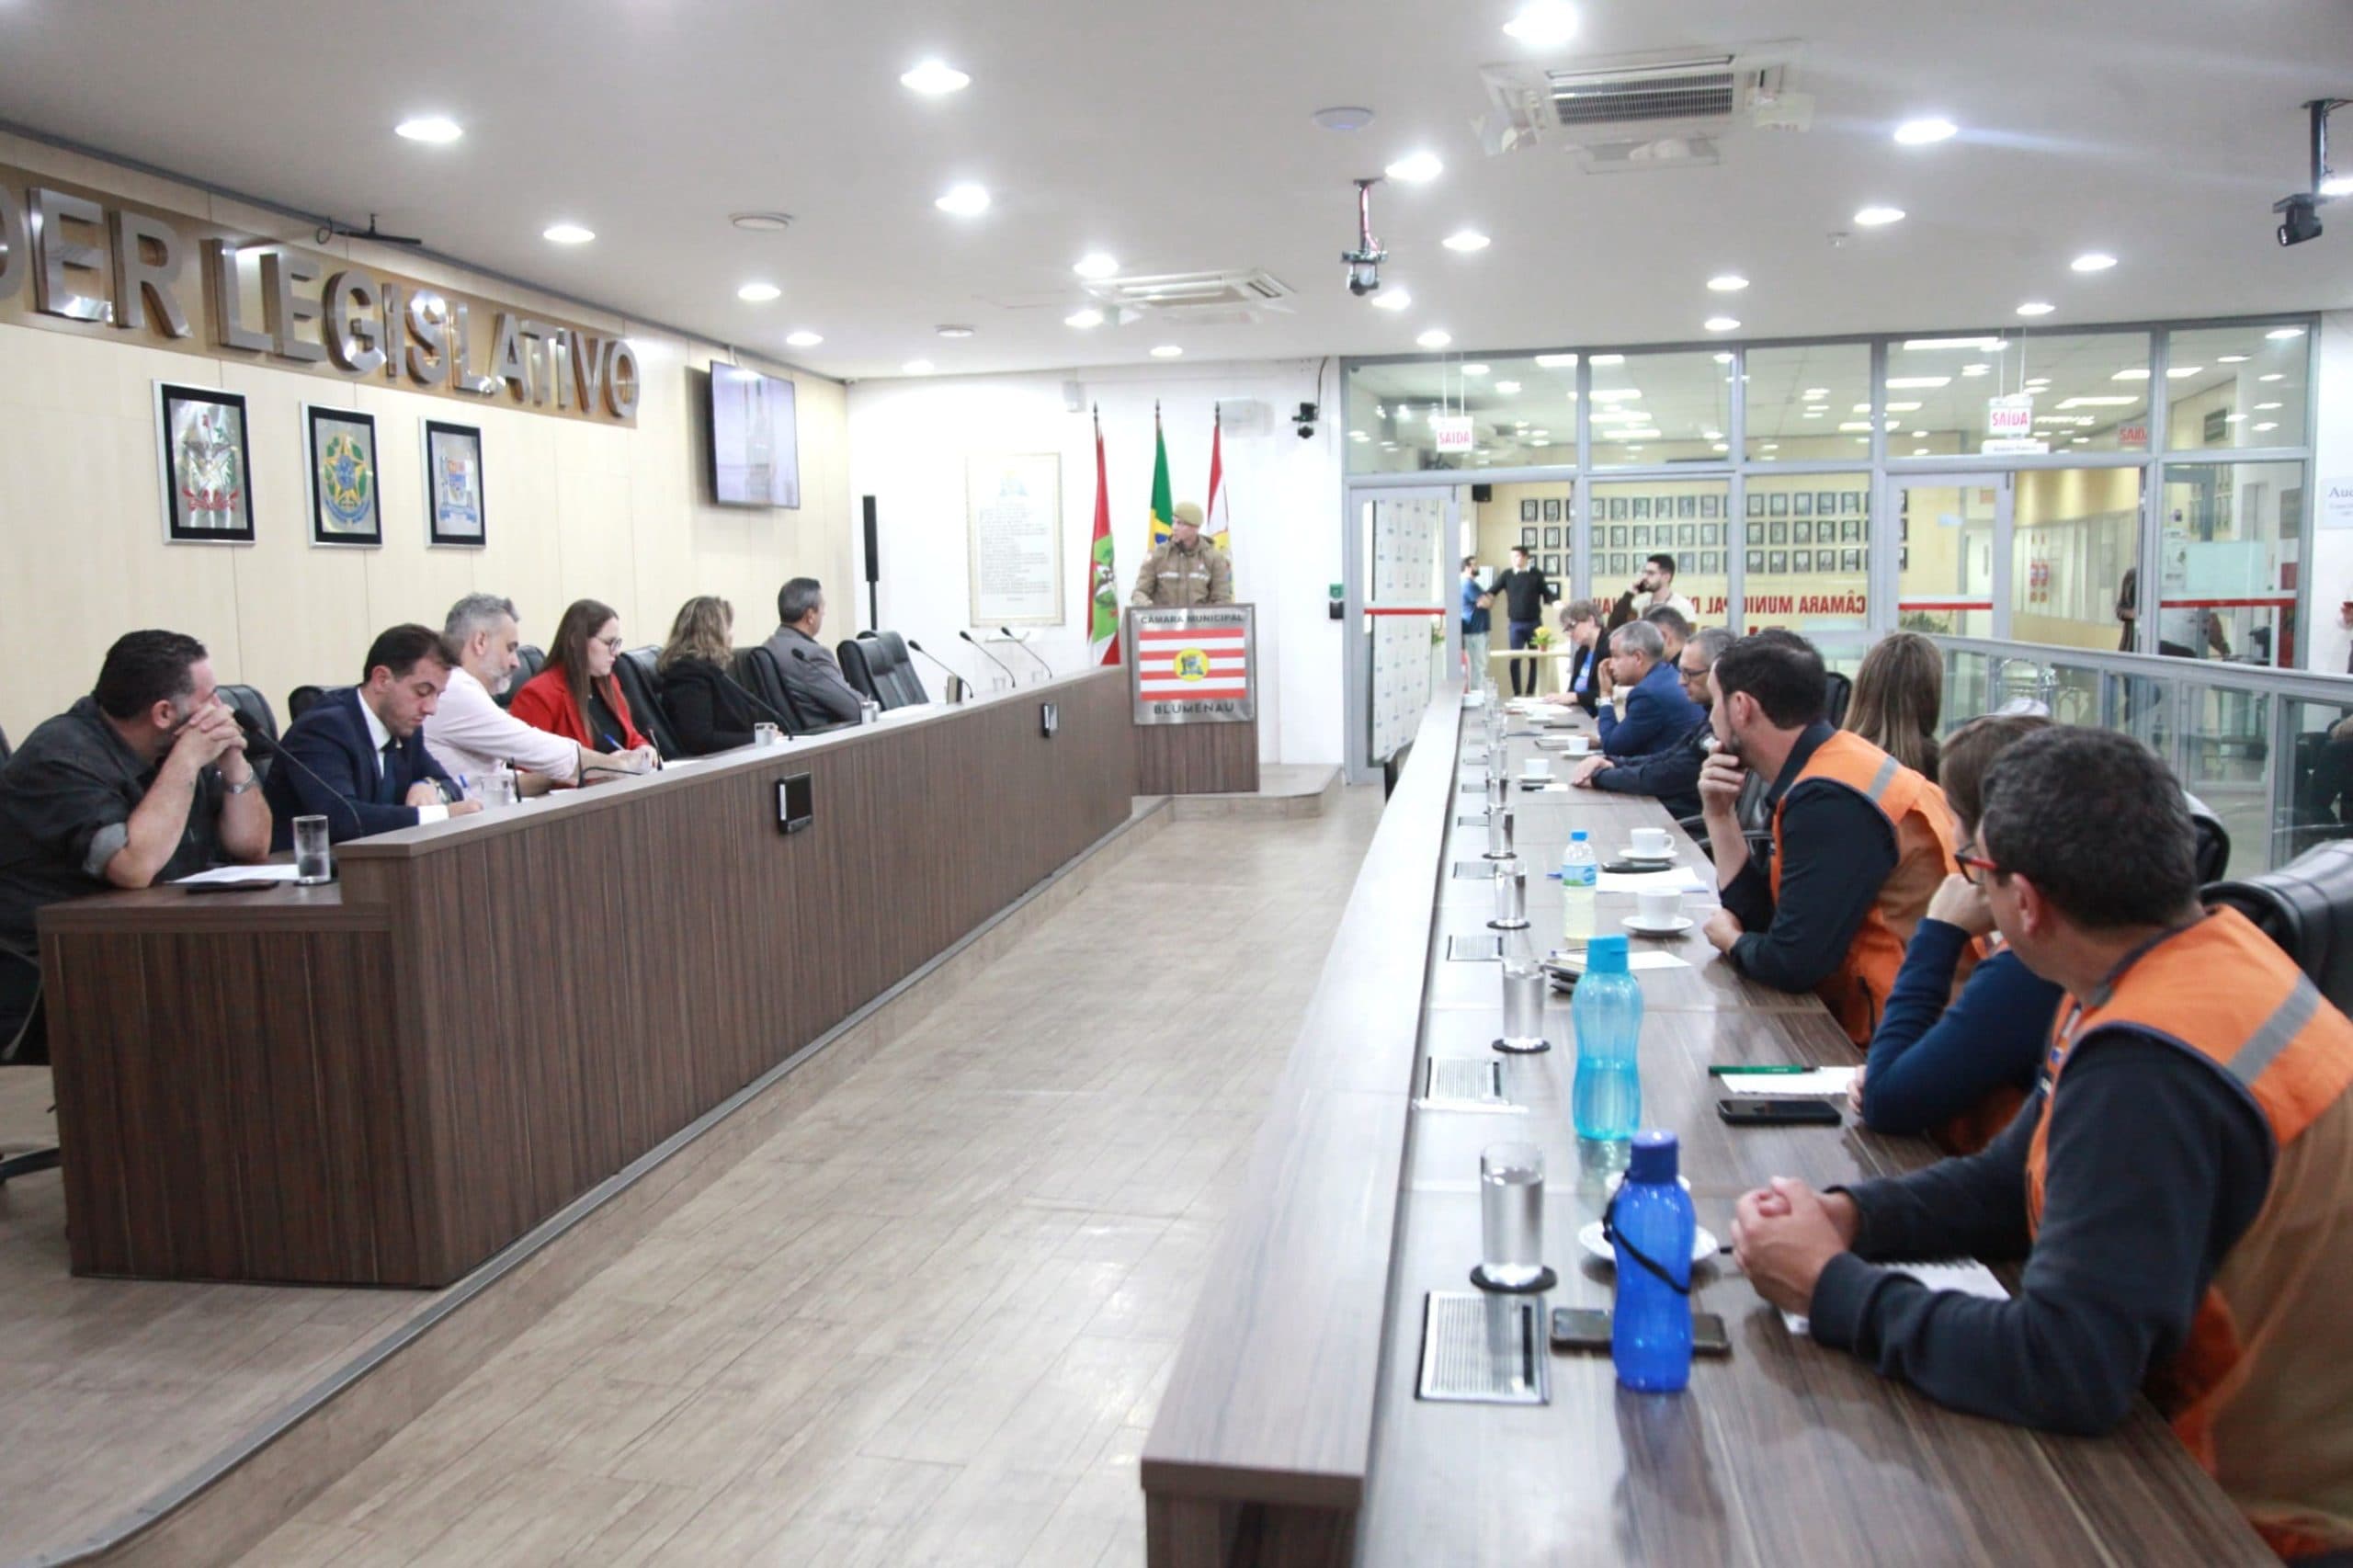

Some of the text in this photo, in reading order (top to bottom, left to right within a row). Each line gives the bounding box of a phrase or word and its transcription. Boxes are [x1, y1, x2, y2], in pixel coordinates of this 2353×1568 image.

[213, 237, 641, 419] LEGISLATIVO
[1187, 614, 1243, 623] MUNICIPAL
[1154, 702, 1234, 715] BLUMENAU
